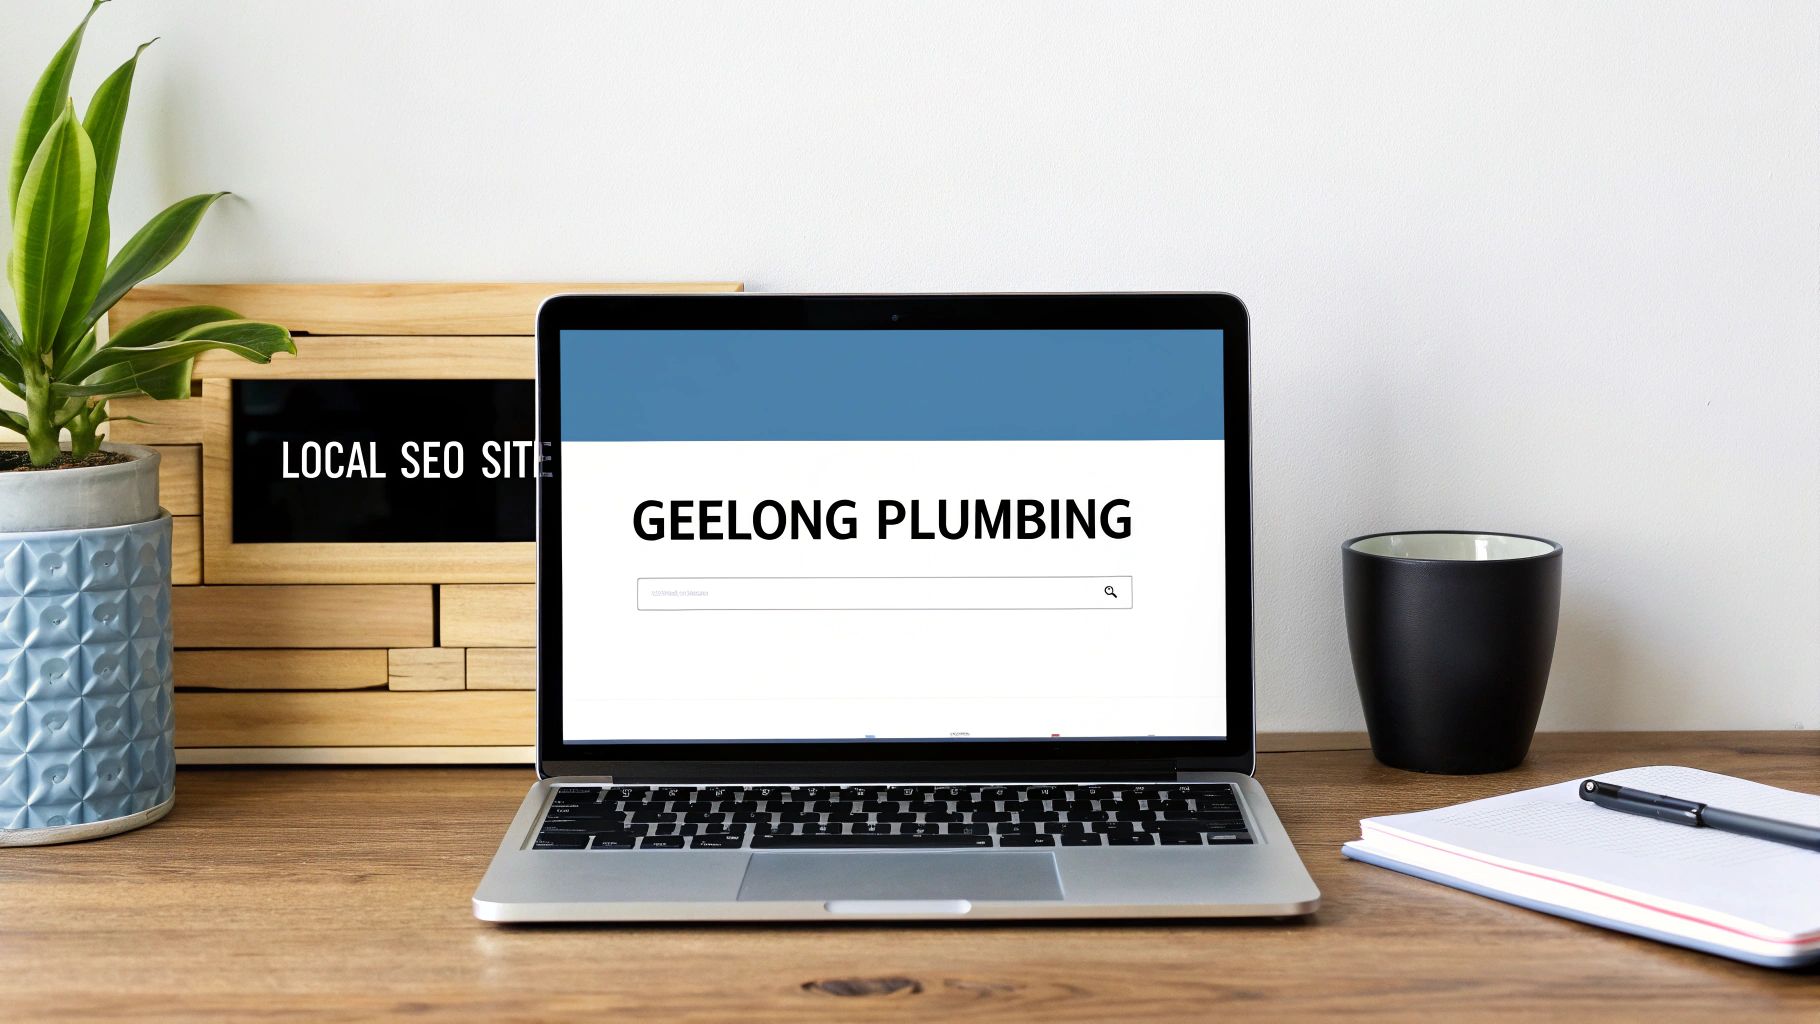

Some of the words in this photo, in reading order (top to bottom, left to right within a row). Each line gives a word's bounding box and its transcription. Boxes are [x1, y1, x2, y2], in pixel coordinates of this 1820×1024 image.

[282, 441, 387, 479] LOCAL
[400, 441, 464, 479] SEO
[633, 499, 858, 542] GEELONG
[878, 498, 1132, 541] PLUMBING
